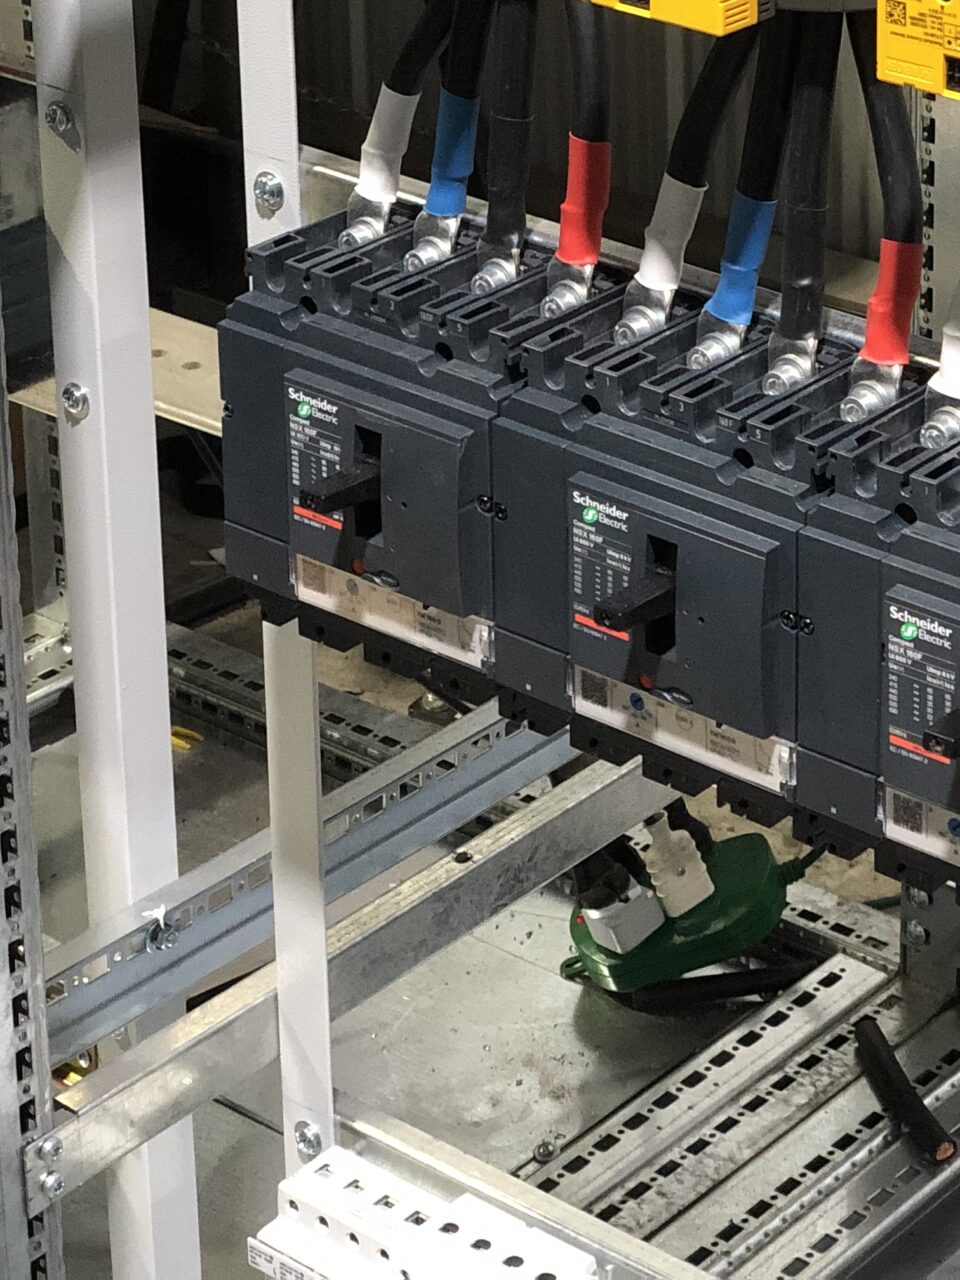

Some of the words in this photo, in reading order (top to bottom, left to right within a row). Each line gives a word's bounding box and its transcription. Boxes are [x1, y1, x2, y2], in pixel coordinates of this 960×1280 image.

[389, 301, 395, 310] 3
[457, 323, 463, 332] 5
[288, 387, 338, 414] Schneider
[679, 402, 684, 412] 3
[311, 407, 338, 425] Electric
[755, 429, 761, 439] 5
[572, 490, 629, 521] Schneider
[598, 513, 628, 532] Electric
[889, 605, 953, 637] Schneider
[918, 628, 952, 650] Electric
[888, 643, 905, 655] NSX
